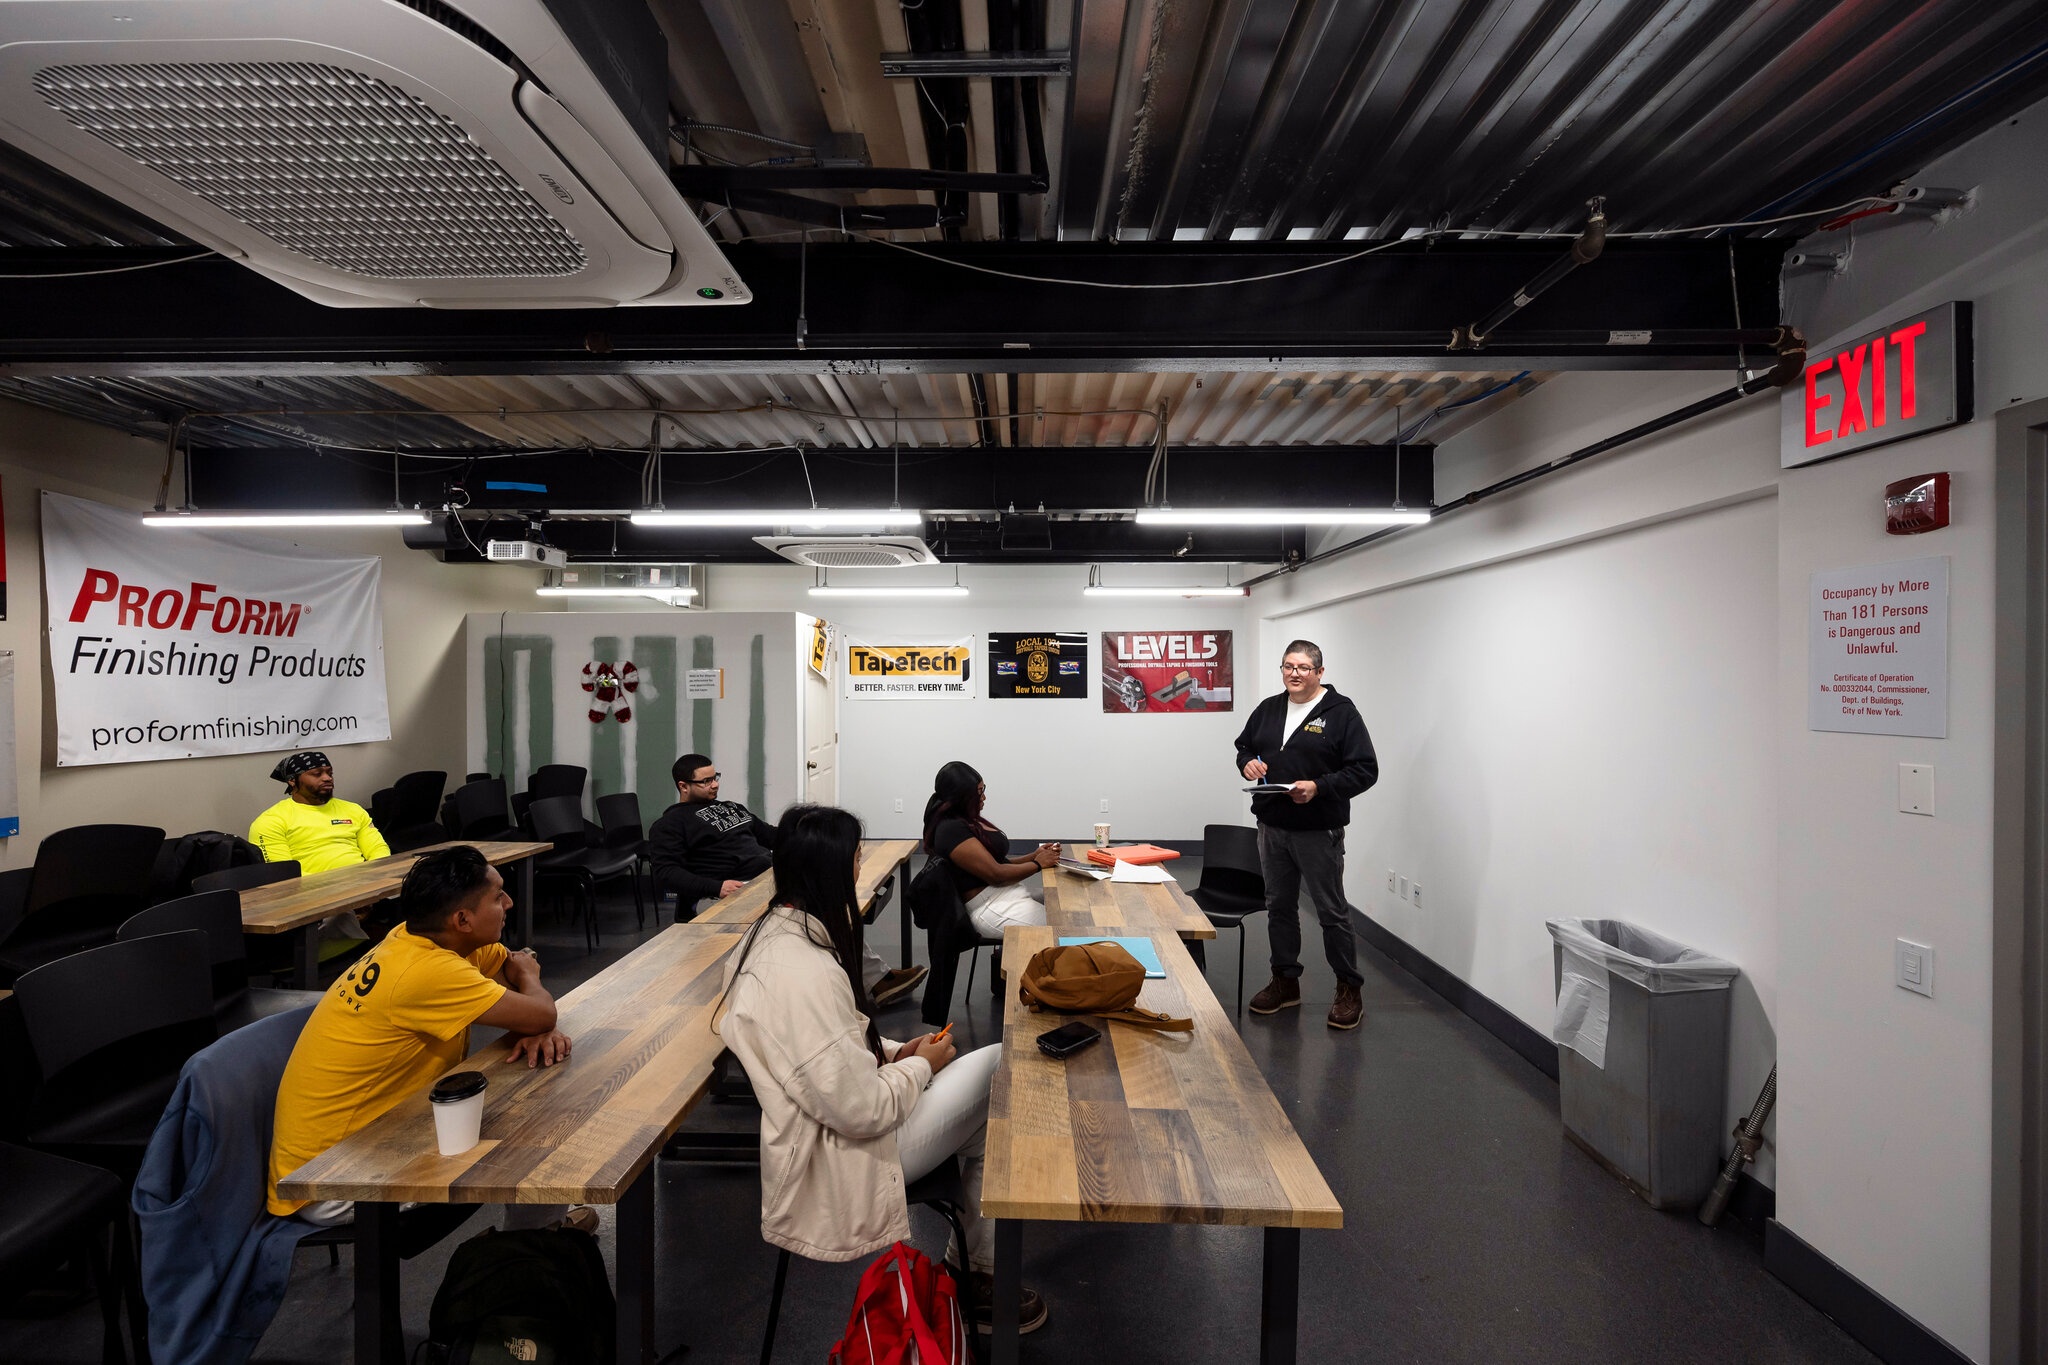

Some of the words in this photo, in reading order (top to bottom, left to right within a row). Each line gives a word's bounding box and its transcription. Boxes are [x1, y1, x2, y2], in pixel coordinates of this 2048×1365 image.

[1805, 321, 1926, 448] EXIT
[1822, 586, 1877, 600] Occupancy
[1881, 583, 1895, 596] by
[1899, 580, 1930, 593] More
[1823, 610, 1847, 621] Than
[1852, 604, 1876, 619] 181
[1882, 605, 1929, 617] Persons
[1828, 627, 1837, 638] is
[1840, 626, 1896, 639] Dangerous
[1899, 621, 1921, 635] and
[1016, 638, 1042, 649] LOCAL
[1117, 634, 1218, 660] LEVEL5
[1847, 641, 1898, 655] Unlawful.
[70, 636, 239, 684] Finishing
[248, 645, 366, 678] Products
[855, 652, 957, 675] TapeTech
[1833, 674, 1868, 682] Certificate
[1870, 674, 1877, 682] of
[1879, 674, 1914, 683] Operation
[854, 684, 885, 692] BETTER.
[887, 684, 916, 692] FASTER.
[918, 684, 942, 692] EVERY
[945, 684, 966, 692] TIME.
[1015, 685, 1030, 694] New
[1031, 685, 1046, 694] York
[1047, 685, 1061, 695] City
[1820, 684, 1831, 692] No.
[1877, 685, 1930, 694] Commissioner,
[1841, 695, 1859, 704] Dept.
[1861, 696, 1868, 704] of
[1870, 696, 1904, 706] Buildings,
[1842, 706, 1855, 715] City
[1857, 707, 1864, 715] of
[1866, 707, 1882, 716] New
[1884, 707, 1903, 716] York.
[92, 715, 358, 751] proformfinishing.com
